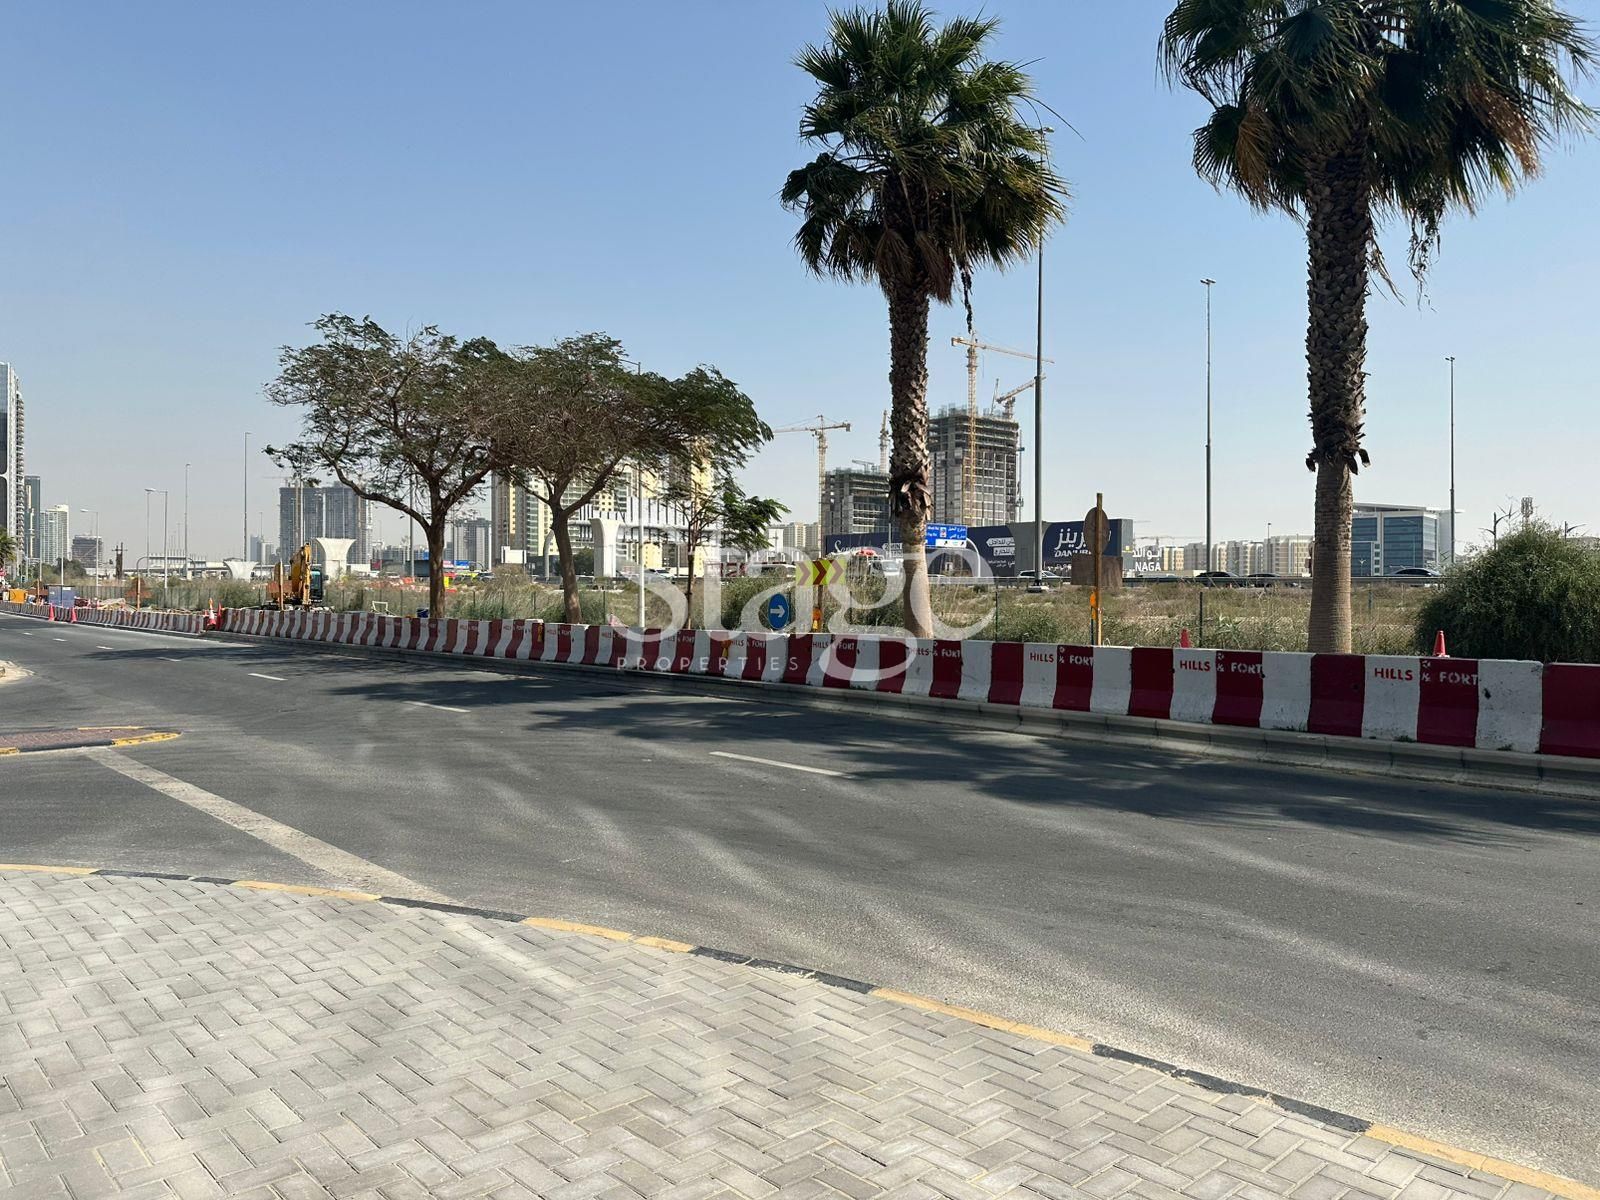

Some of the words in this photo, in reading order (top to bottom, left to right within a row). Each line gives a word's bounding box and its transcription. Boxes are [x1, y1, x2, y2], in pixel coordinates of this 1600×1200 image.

[941, 648, 961, 658] FORT
[1029, 652, 1054, 663] HILLS
[1069, 655, 1094, 667] FORT
[1180, 660, 1211, 672] HILLS
[1231, 662, 1263, 674] FORT
[1374, 667, 1413, 681] HILLS
[1439, 671, 1479, 686] FORT
